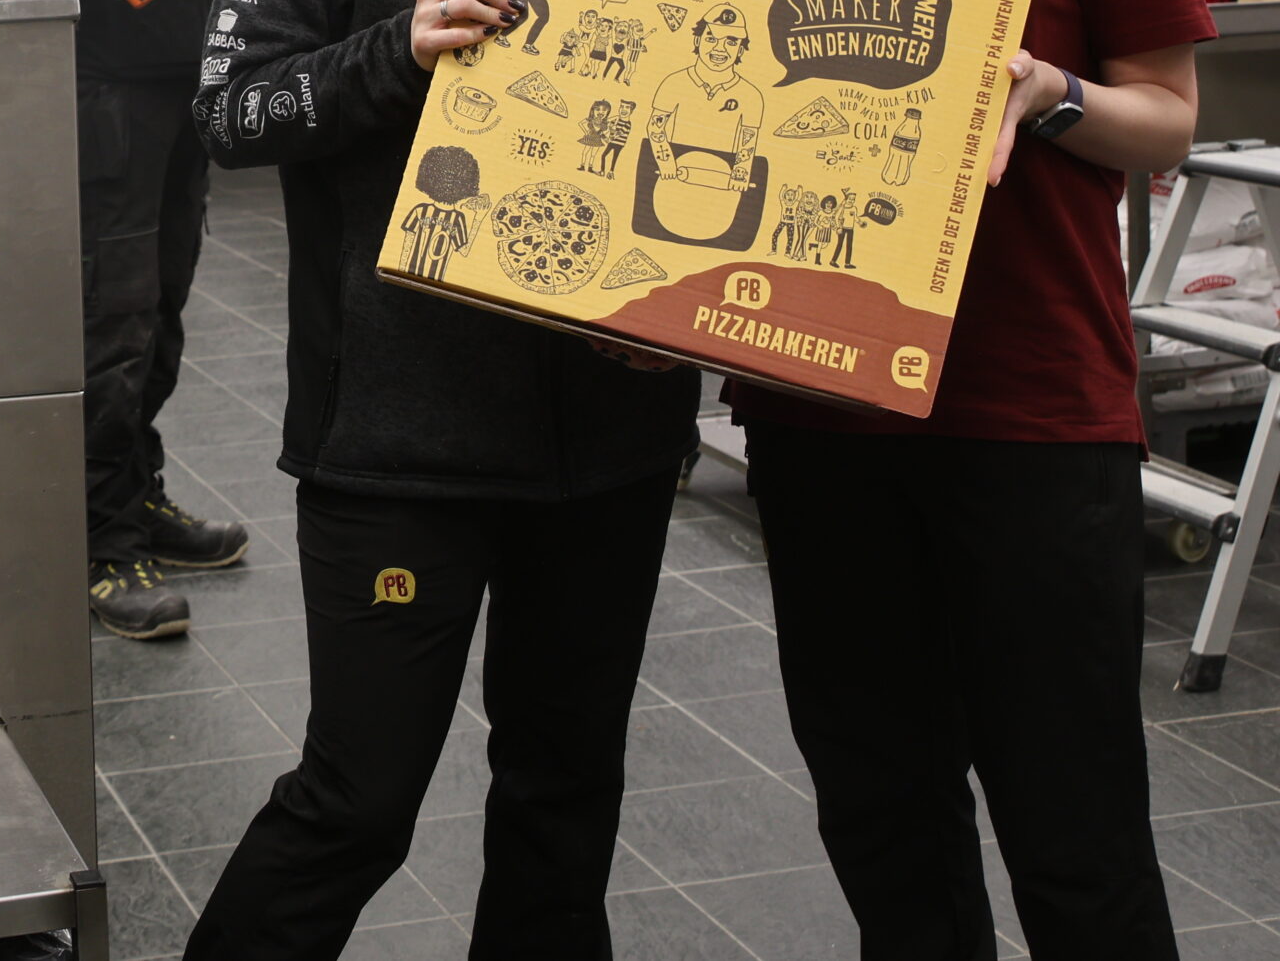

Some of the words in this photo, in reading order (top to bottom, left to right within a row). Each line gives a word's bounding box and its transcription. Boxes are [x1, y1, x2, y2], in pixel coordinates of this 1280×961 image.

[991, 0, 1014, 42] KANTEN
[787, 34, 823, 61] ENN
[826, 32, 859, 56] DEN
[863, 33, 930, 67] KOSTER
[986, 43, 1003, 59] PÅ
[980, 61, 998, 89] HELT
[296, 73, 317, 128] Fatland
[838, 88, 868, 103] VARMT
[976, 90, 992, 105] ER
[244, 91, 258, 130] Dole
[840, 101, 858, 112] NED
[860, 107, 880, 121] MED
[885, 111, 896, 122] EN
[970, 107, 988, 131] SOM
[854, 122, 887, 140] COLA
[518, 135, 550, 159] YES
[964, 133, 981, 156] HAR
[960, 158, 976, 170] VI
[949, 173, 972, 214] ENESTE
[868, 202, 881, 216] PB
[944, 216, 961, 239] DET
[939, 240, 955, 256] ER
[930, 257, 952, 294] OSTEN
[736, 277, 761, 302] PB
[693, 305, 858, 373] PIZZABAKEREN
[898, 355, 922, 378] PB
[384, 573, 408, 598] PB
